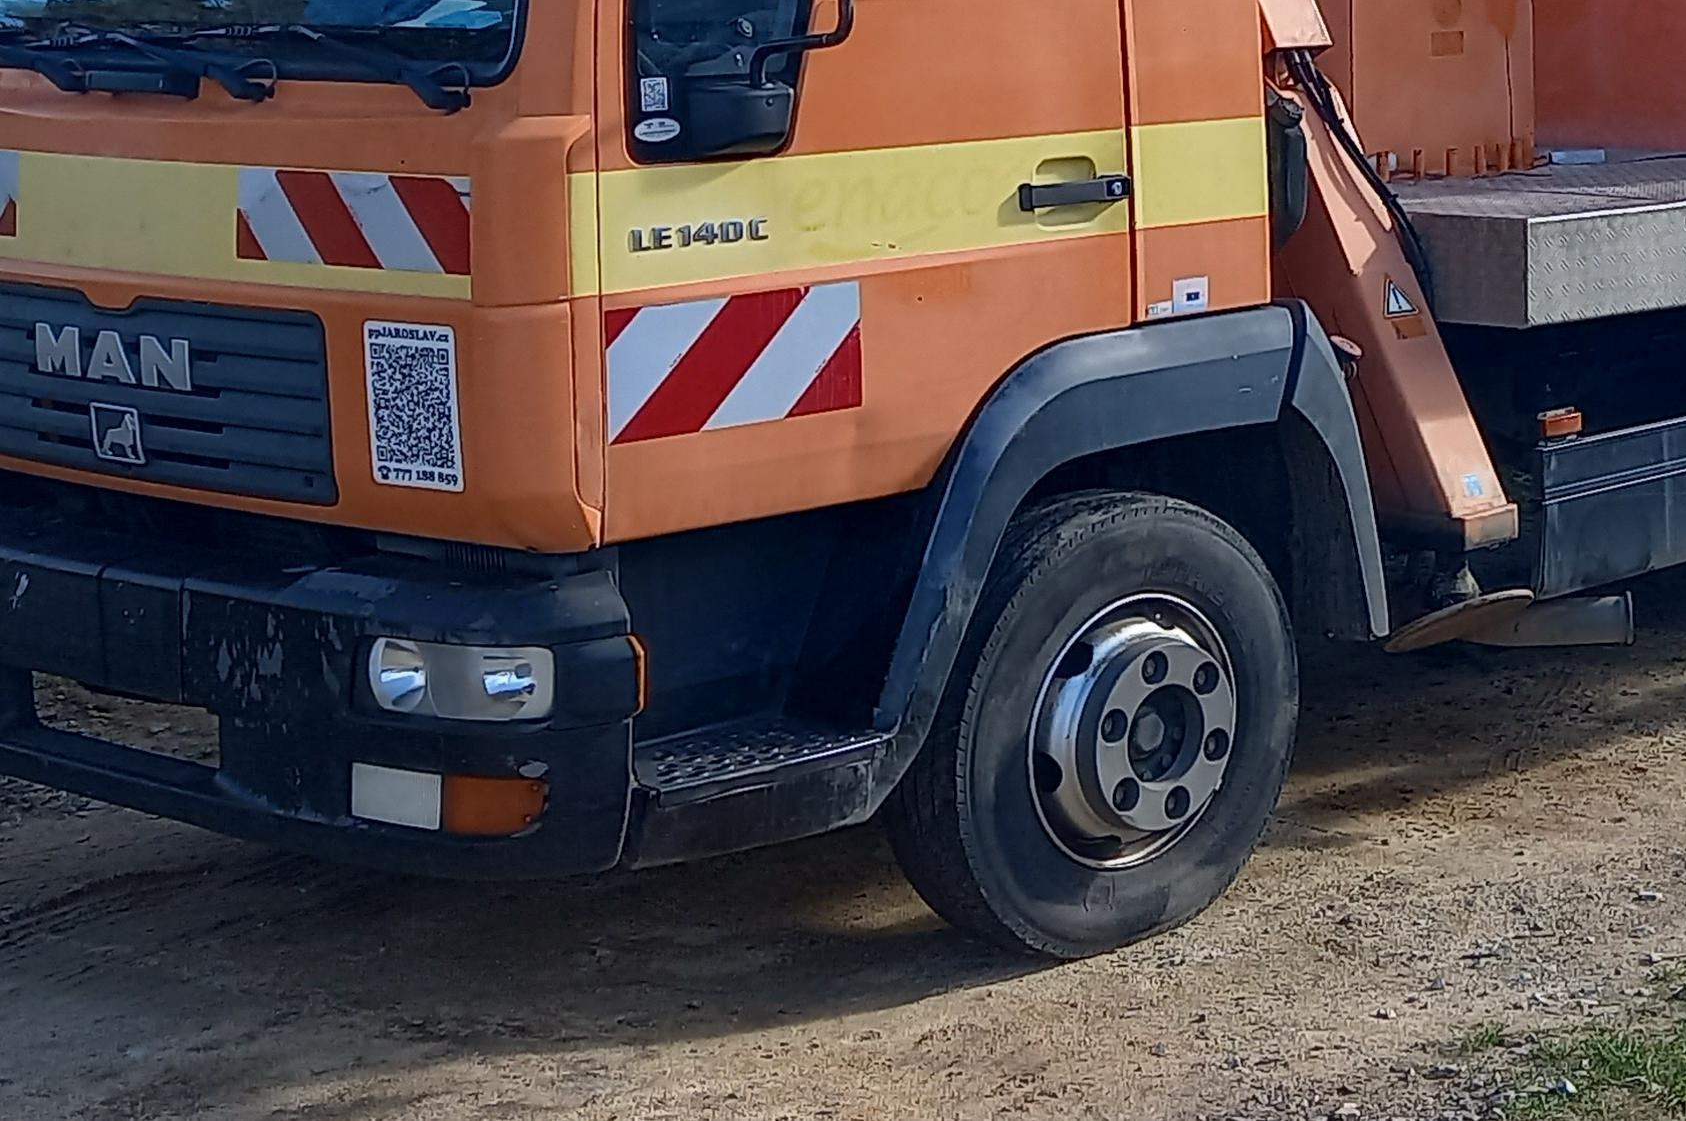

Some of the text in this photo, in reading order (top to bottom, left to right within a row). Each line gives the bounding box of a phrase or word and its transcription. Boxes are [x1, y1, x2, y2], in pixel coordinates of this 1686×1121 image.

[34, 322, 192, 391] MAN
[392, 467, 459, 487] 777 188 859
